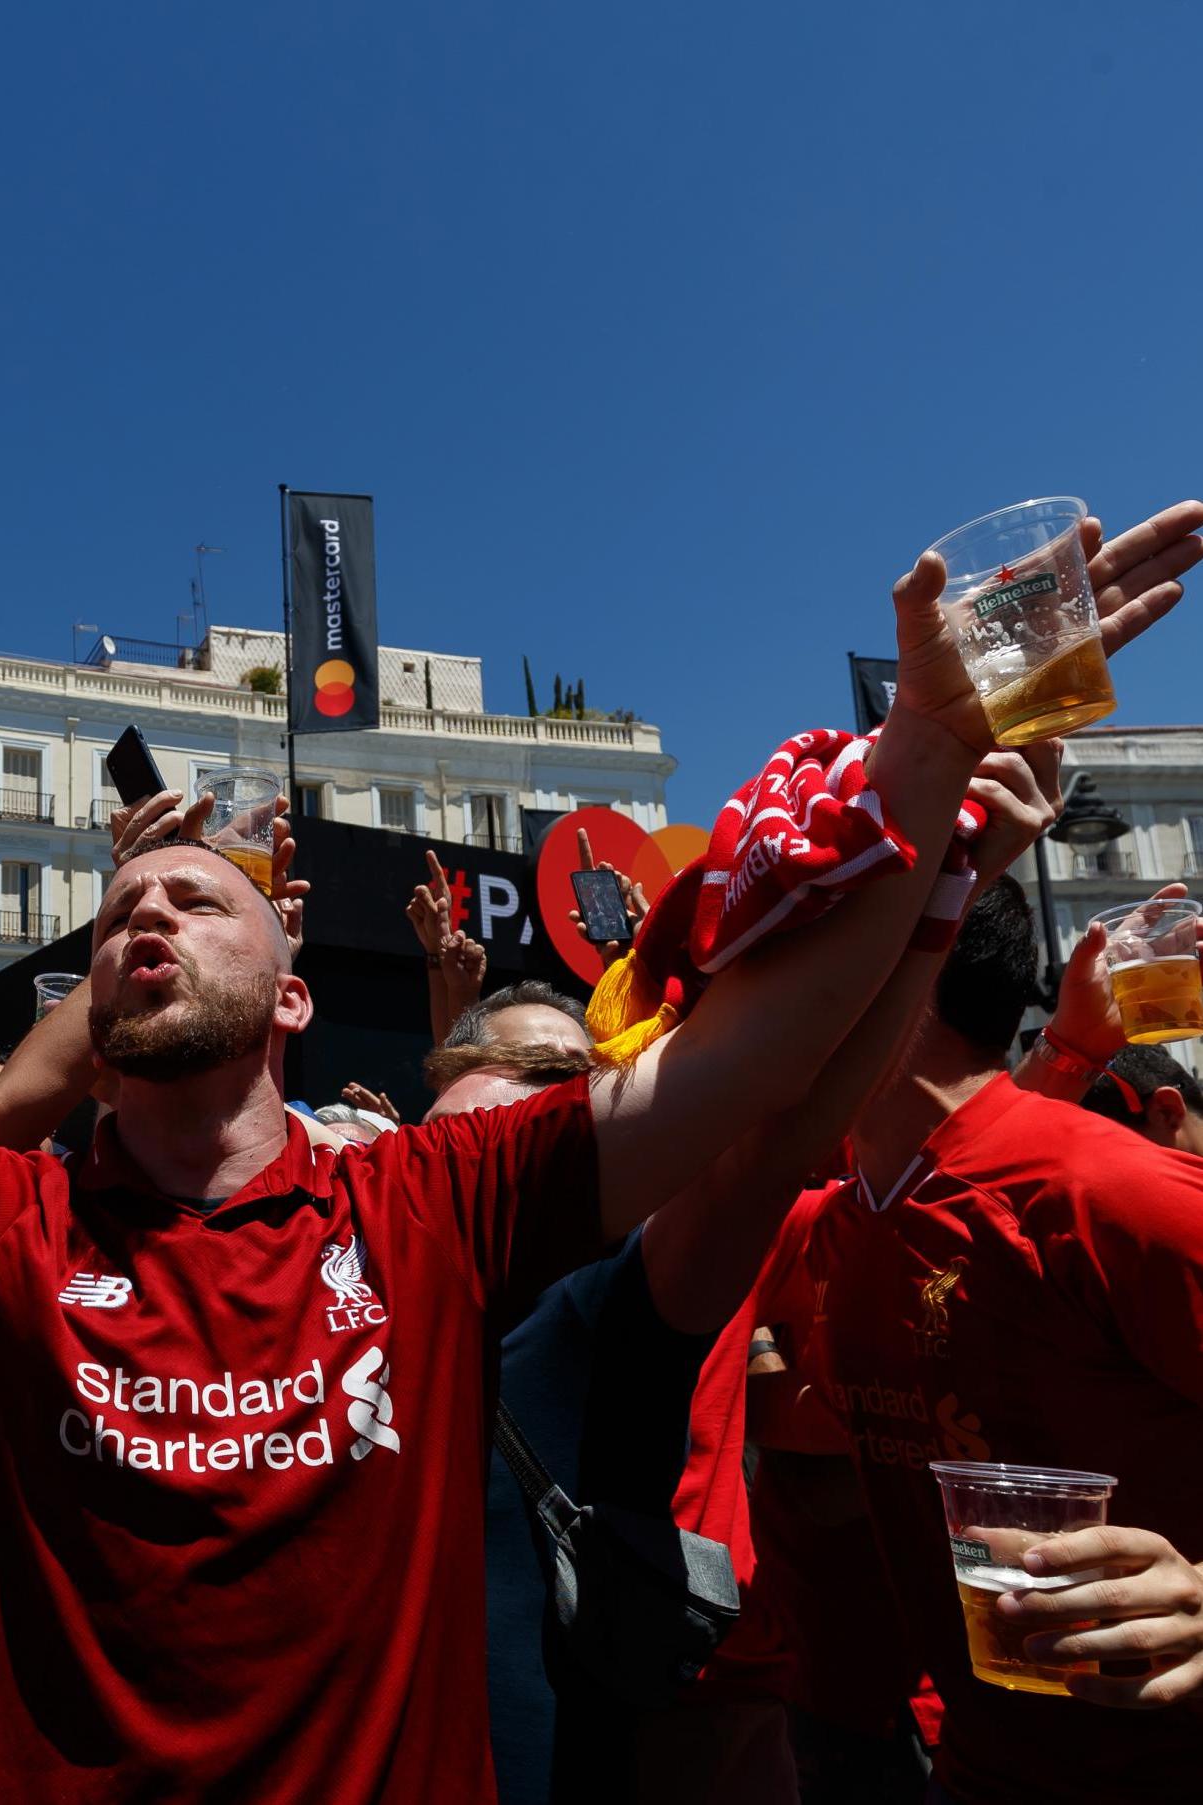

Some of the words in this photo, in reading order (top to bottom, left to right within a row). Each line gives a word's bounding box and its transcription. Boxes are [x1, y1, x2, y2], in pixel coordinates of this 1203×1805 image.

[320, 519, 343, 650] mastercard
[976, 577, 1054, 615] Heineken
[429, 866, 534, 945] #P
[76, 1358, 325, 1418] Standard
[59, 1408, 334, 1473] Chartered
